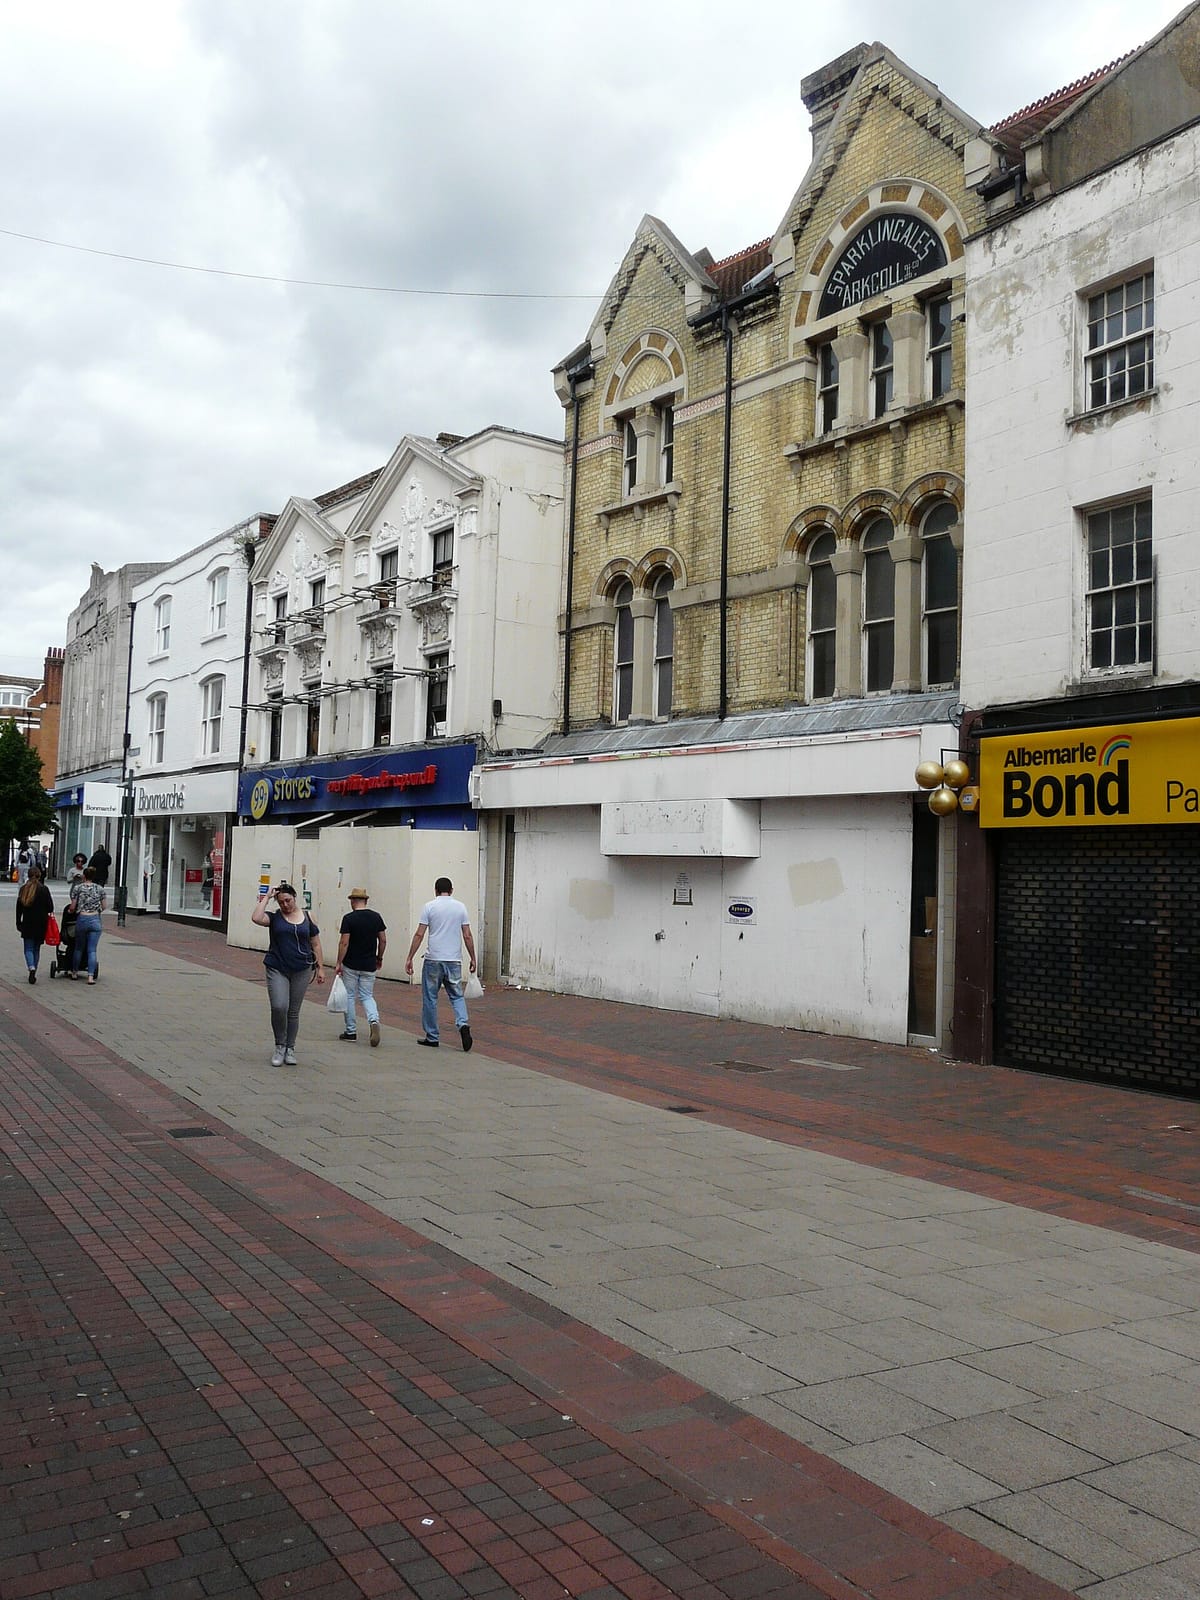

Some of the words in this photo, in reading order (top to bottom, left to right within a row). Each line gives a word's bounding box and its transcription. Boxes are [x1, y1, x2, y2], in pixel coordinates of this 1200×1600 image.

[842, 262, 904, 308] ARKCOLL
[1003, 742, 1097, 768] Albemarle
[273, 776, 311, 801] stores
[1003, 759, 1130, 818] Bond
